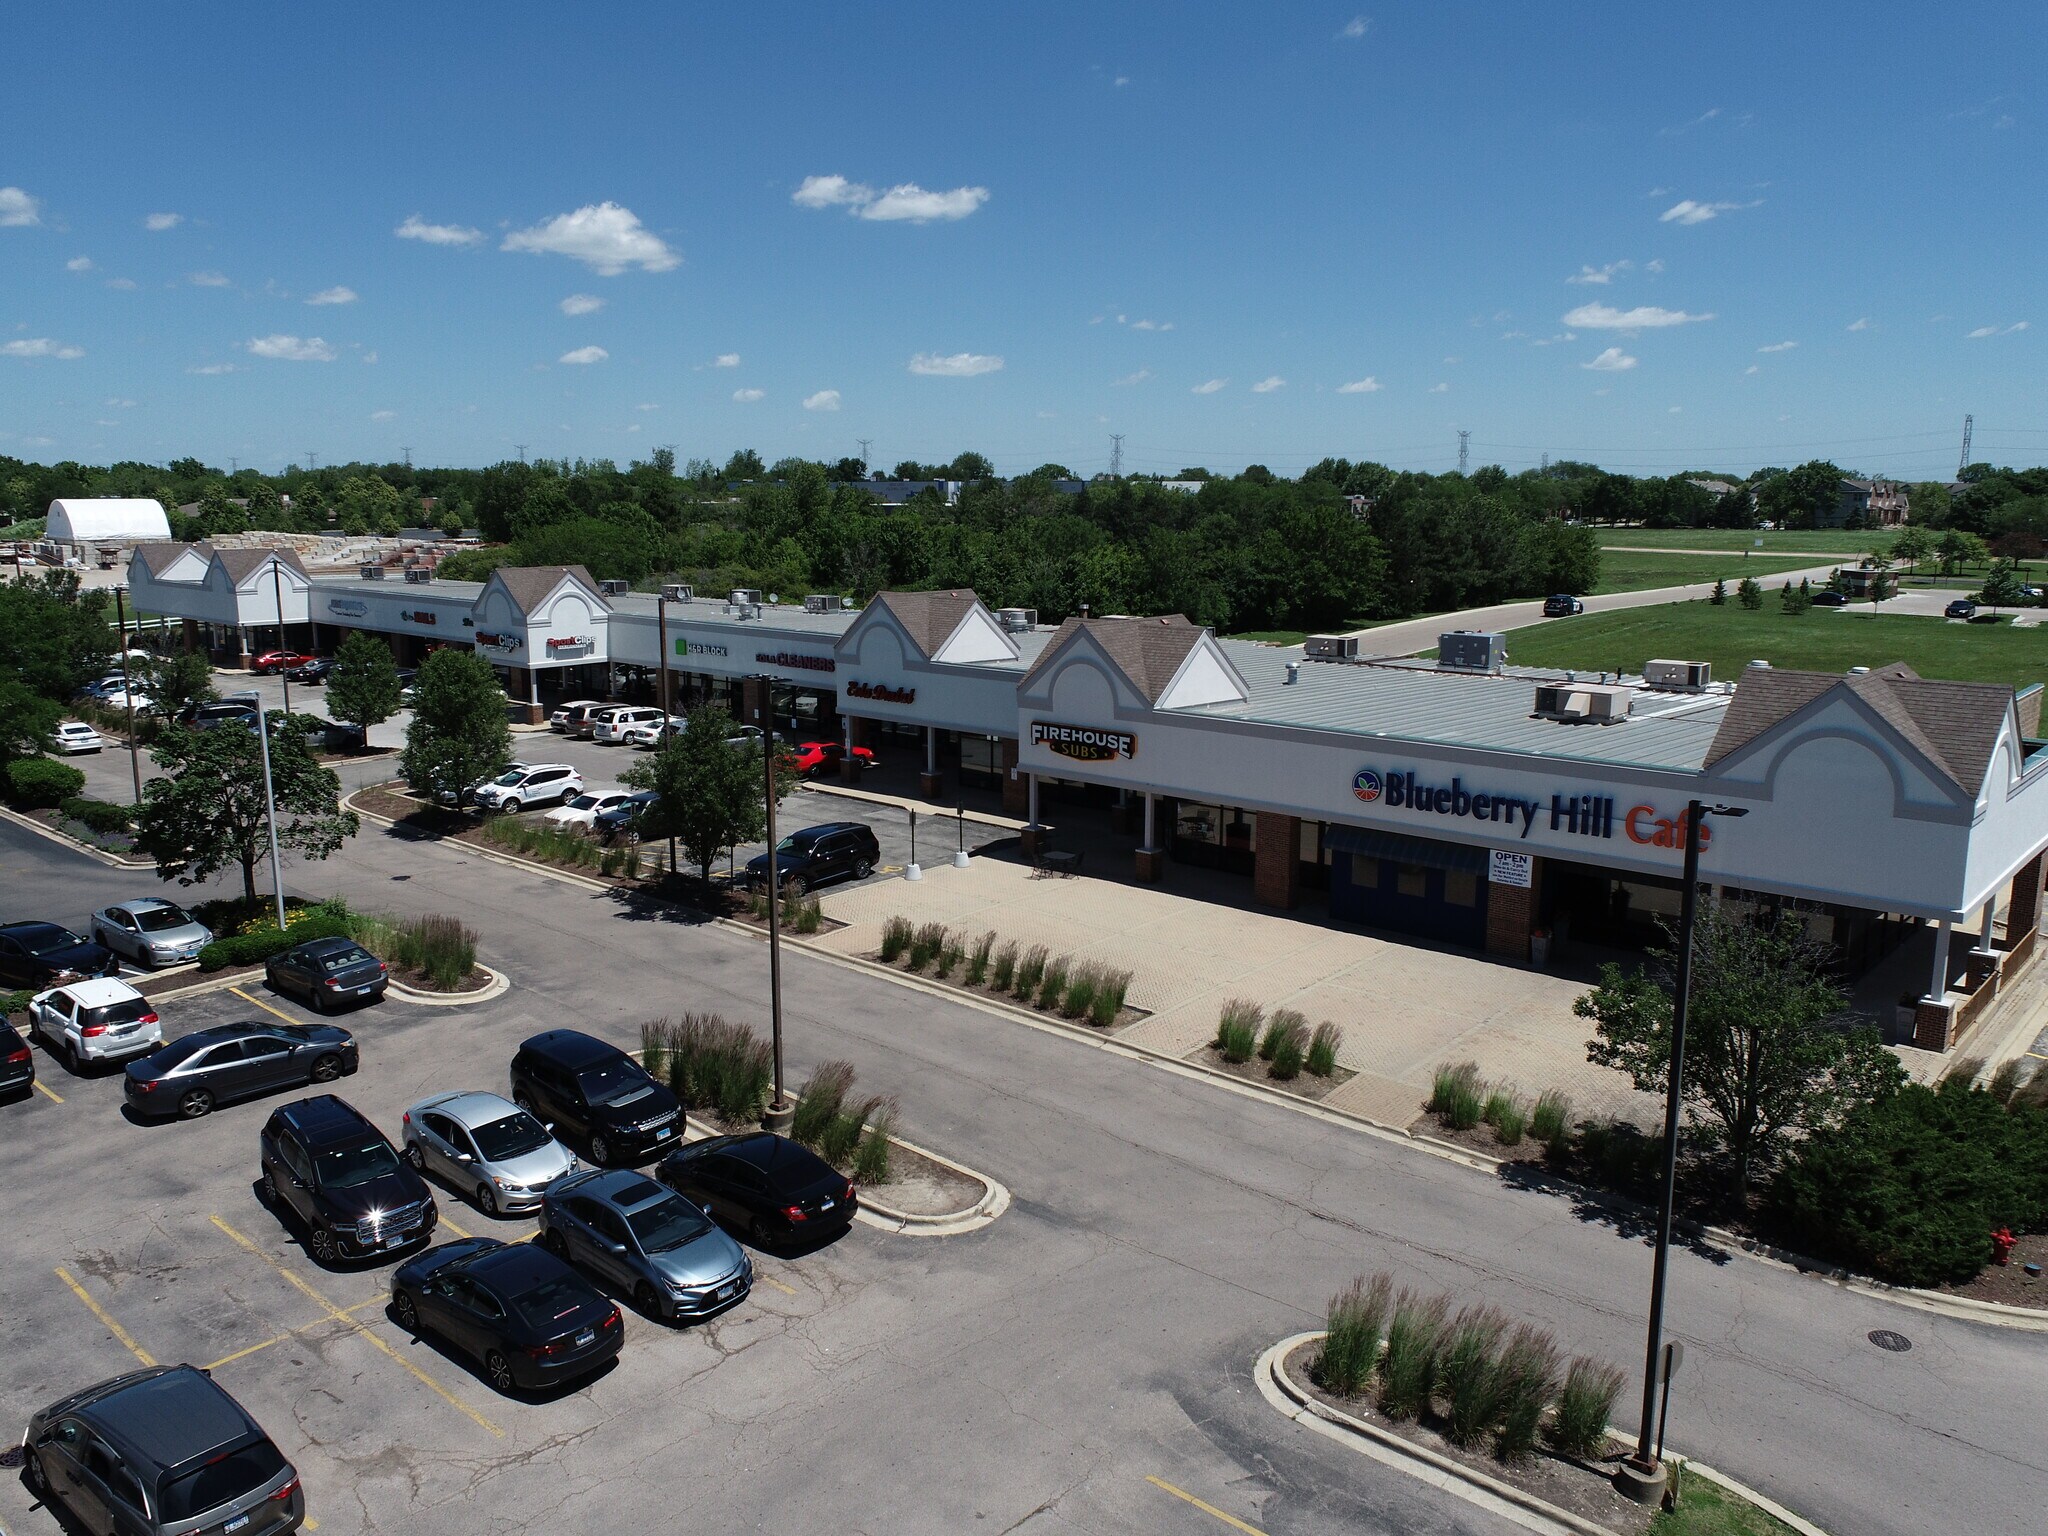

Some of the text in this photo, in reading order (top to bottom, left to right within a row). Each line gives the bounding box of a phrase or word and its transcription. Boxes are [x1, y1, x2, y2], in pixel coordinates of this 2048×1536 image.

[702, 646, 727, 657] BLOCK
[776, 653, 836, 672] CLEANERS
[1031, 724, 1131, 759] FIREHOUSE
[1061, 743, 1097, 759] SUBS
[1386, 772, 1539, 839] Blueberry
[1550, 794, 1613, 839] Hill
[1495, 852, 1528, 864] OPEN
